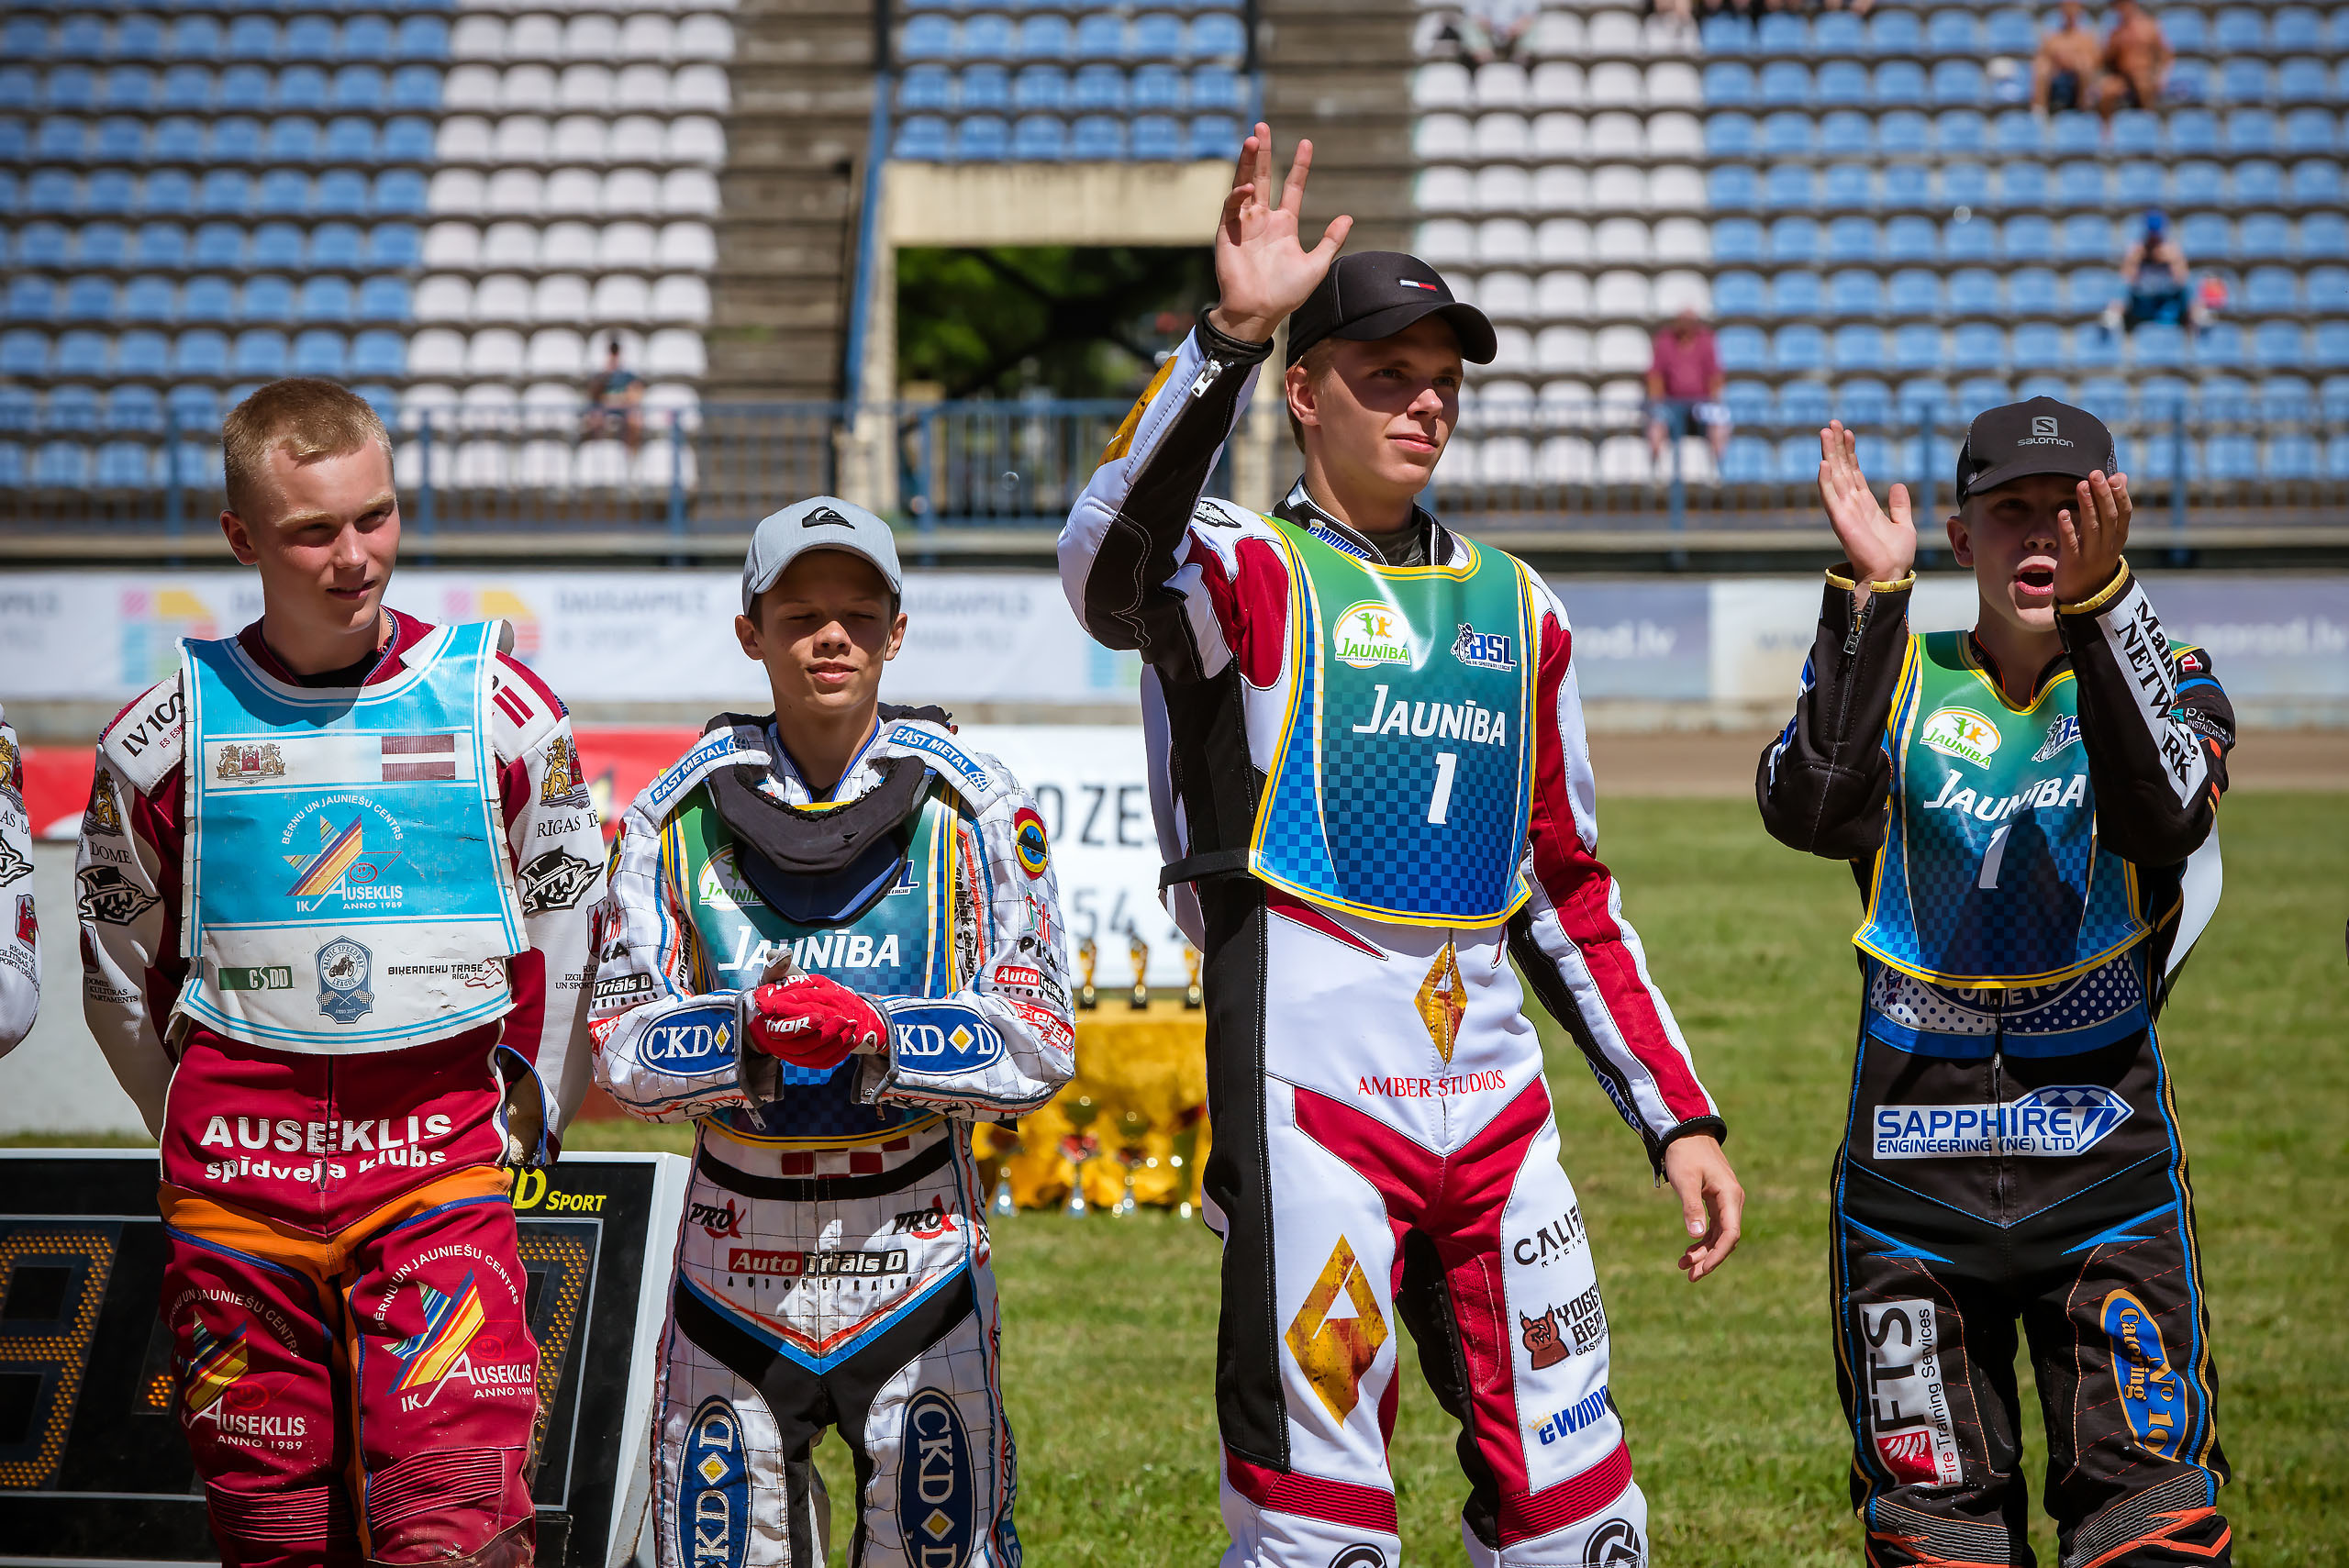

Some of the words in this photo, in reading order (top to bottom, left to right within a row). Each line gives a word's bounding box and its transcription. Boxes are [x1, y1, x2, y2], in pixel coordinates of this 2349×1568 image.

[2017, 437, 2074, 448] salomon
[1469, 633, 1517, 666] BSL
[1352, 684, 1507, 747] JAUNĪBA
[2114, 617, 2192, 788] NETWRK
[893, 726, 931, 746] EAST
[927, 735, 970, 773] METAL
[652, 771, 683, 802] EAST
[680, 741, 728, 778] METAL
[1427, 751, 1458, 826] 1
[1923, 767, 2087, 822] JAUNĪBA
[282, 811, 306, 846] BĒRNU
[306, 800, 320, 814] UN
[320, 794, 373, 809] JAUNIEŠU
[373, 804, 405, 841] CENTRS
[90, 840, 133, 866] DOME
[381, 901, 403, 909] 1989
[451, 963, 484, 973] TRASE
[996, 968, 1038, 984] Auto
[764, 1016, 812, 1035] THOR
[892, 1023, 946, 1056] KD
[1357, 1075, 1432, 1098] AMBER
[1438, 1069, 1507, 1097] STUDIOS
[199, 1113, 453, 1154] AUSEKLIS
[1877, 1107, 2072, 1139] SAPPHIRE
[1876, 1138, 1993, 1153] ENGINEERING
[1998, 1138, 2037, 1153] (NE)
[2042, 1136, 2076, 1152] LTD
[545, 1190, 607, 1212] SPORT
[732, 1251, 798, 1273] Auto
[375, 1284, 400, 1331] BĒRNU
[392, 1263, 412, 1284] UN
[411, 1243, 483, 1271] JAUNIEŠU
[484, 1253, 519, 1306] CENTRS
[1918, 1307, 1937, 1379] Services
[2119, 1307, 2147, 1402] Catering
[1863, 1307, 1927, 1434] FTS
[473, 1386, 516, 1399] ANNO
[518, 1385, 534, 1396] 1989
[1927, 1382, 1952, 1451] Training
[2143, 1407, 2175, 1455] 10
[217, 1434, 263, 1449] ANNO
[271, 1440, 304, 1451] 1989
[1942, 1451, 1959, 1486] Fire
